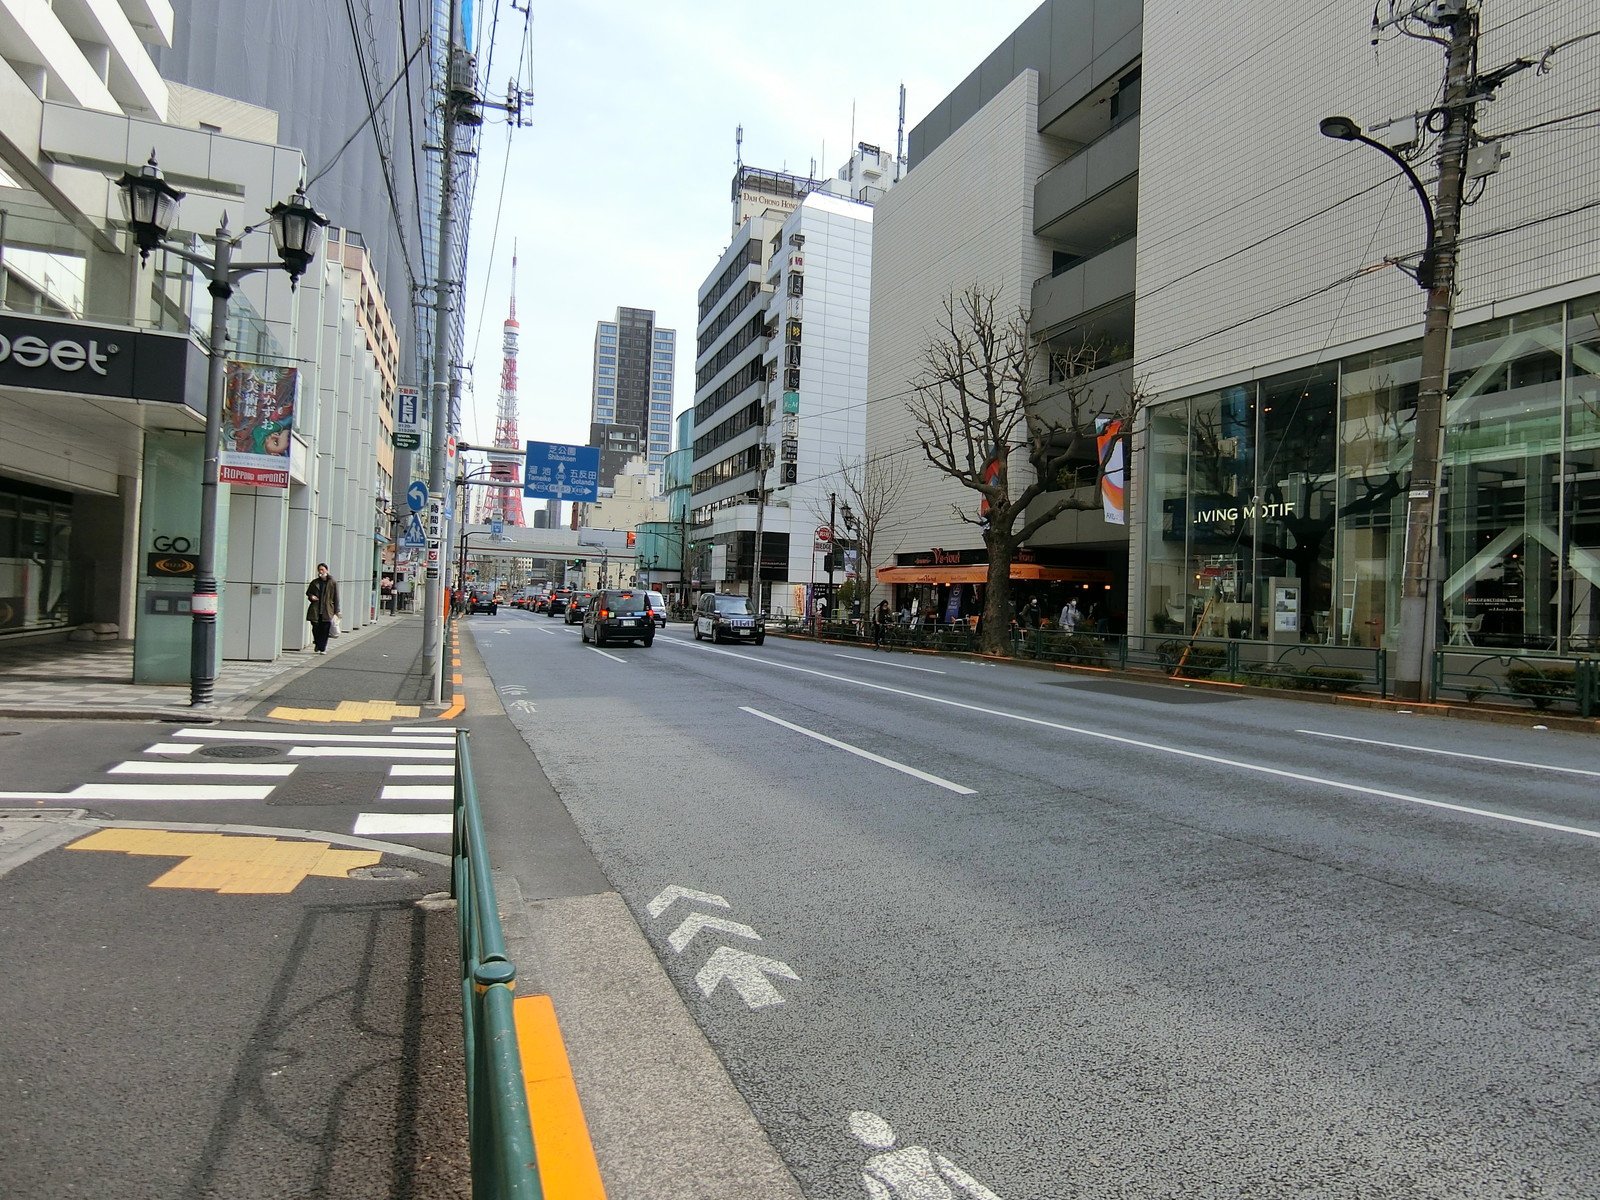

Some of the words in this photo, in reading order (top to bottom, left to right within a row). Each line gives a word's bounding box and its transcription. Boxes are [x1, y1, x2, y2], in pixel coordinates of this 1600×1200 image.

[402, 396, 414, 424] KEN
[548, 445, 577, 456] 芝公園
[547, 453, 577, 463] Shibakoen
[570, 469, 597, 480] 五反田
[570, 477, 595, 486] Gotanda
[429, 503, 440, 535] 時間貸
[1193, 508, 1238, 523] IVING
[153, 535, 191, 553] GO
